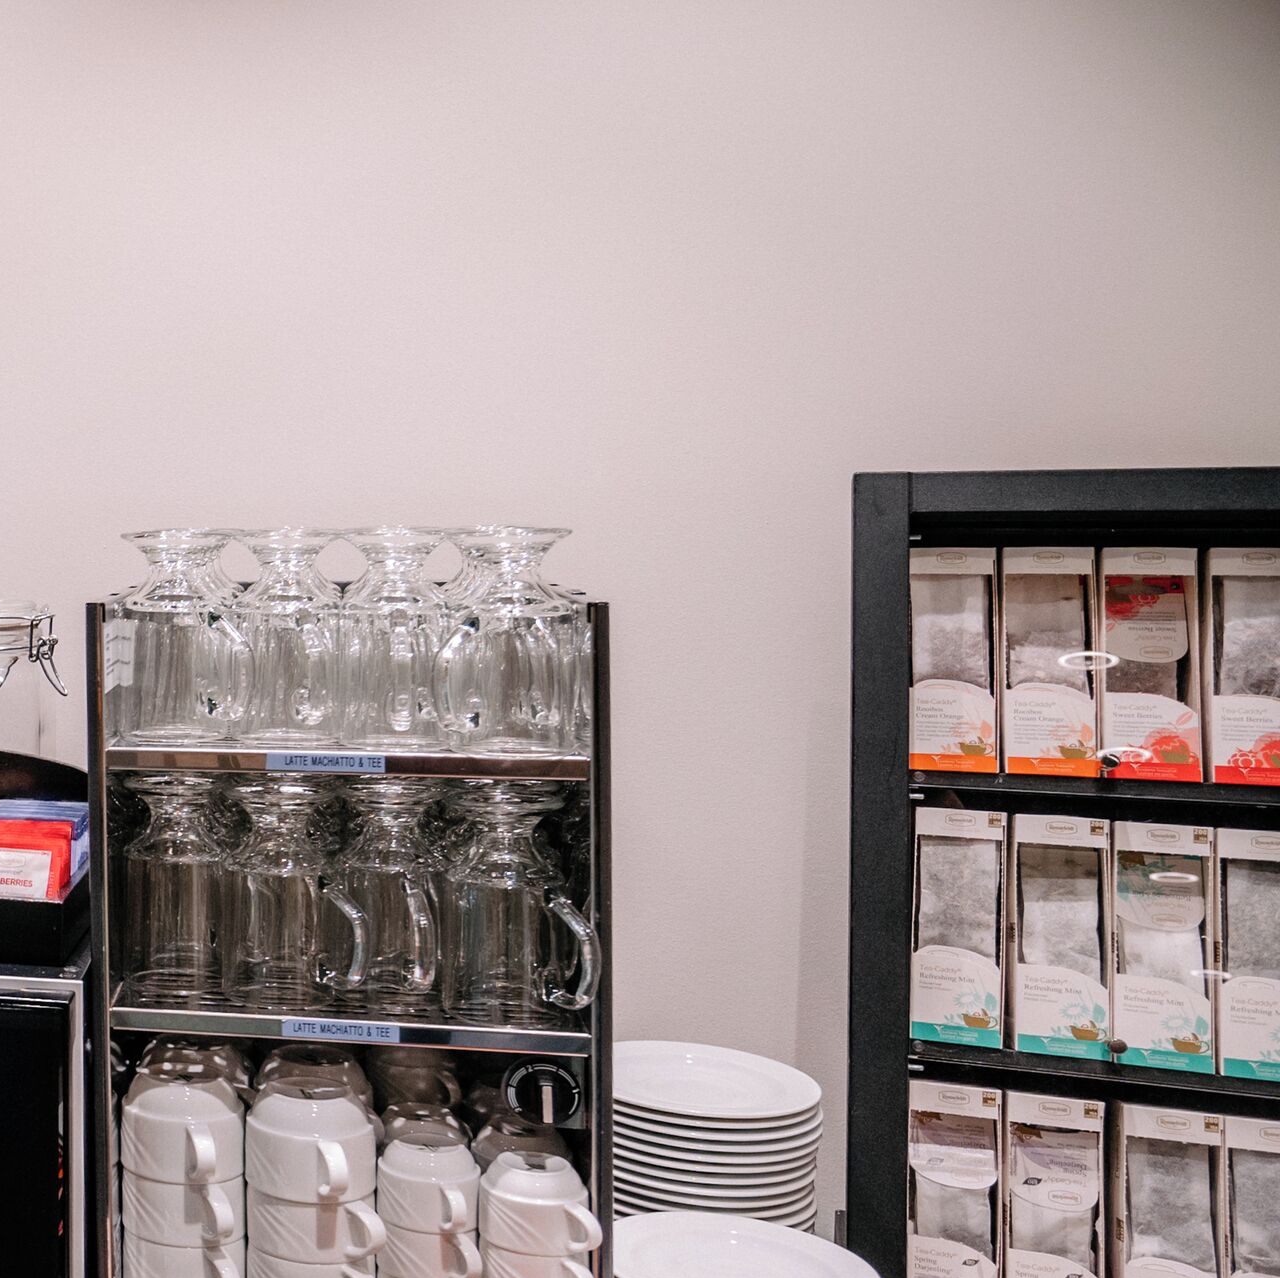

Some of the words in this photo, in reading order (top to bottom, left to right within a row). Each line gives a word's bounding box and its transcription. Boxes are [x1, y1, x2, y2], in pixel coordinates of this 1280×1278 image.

[284, 755, 308, 766] LATTE
[311, 756, 355, 767] MACHIATTO
[358, 757, 364, 768] &
[367, 757, 382, 768] TEE
[0, 877, 33, 888] BERRIES
[919, 972, 958, 983] Refreshing
[1024, 984, 1063, 994] Refreshing
[1123, 995, 1165, 1006] Refreshing
[1230, 1005, 1273, 1016] Refreshing
[293, 1022, 317, 1034] LATTE
[320, 1023, 364, 1036] MACHIATTO
[366, 1026, 372, 1037] &
[376, 1027, 391, 1038] TEE
[526, 1065, 534, 1073] 2
